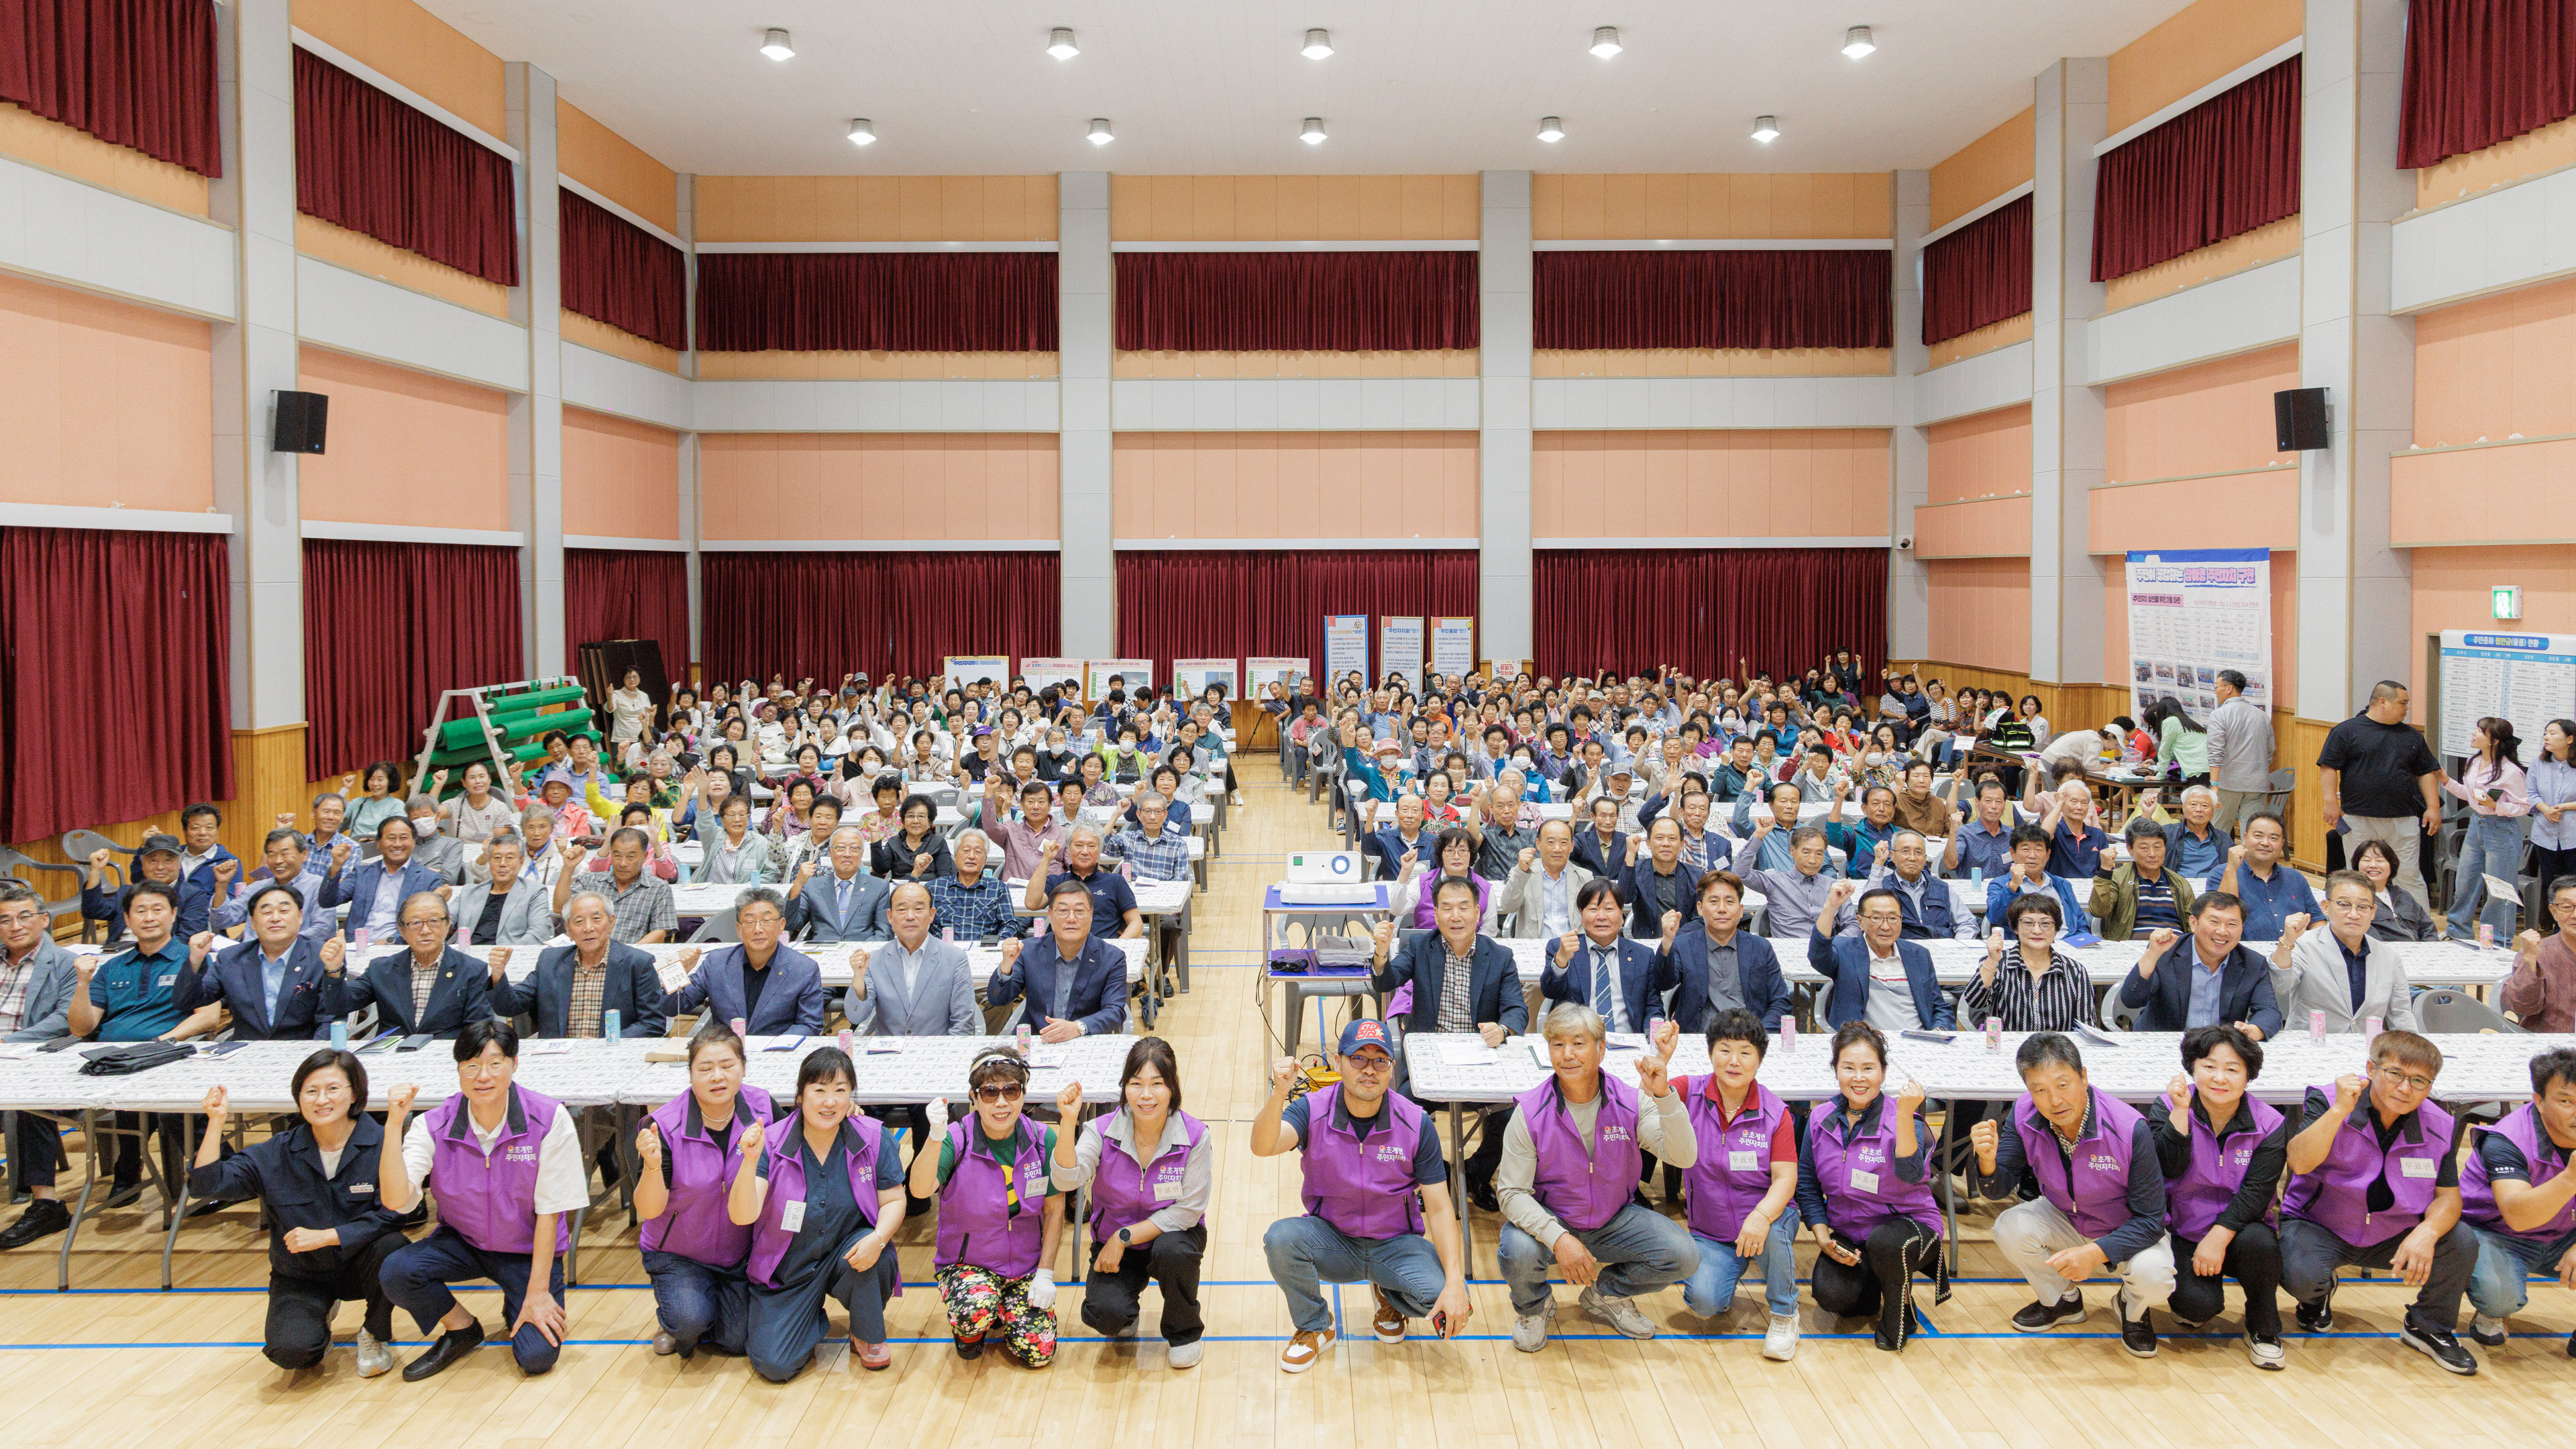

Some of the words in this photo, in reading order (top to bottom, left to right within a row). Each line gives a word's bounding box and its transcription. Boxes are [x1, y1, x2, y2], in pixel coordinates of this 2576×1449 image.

[2136, 568, 2156, 582] 주민이
[2238, 568, 2255, 584] 구현
[2473, 636, 2493, 645] 주민총회
[2528, 638, 2539, 648] 현황
[1748, 1131, 1766, 1141] 초계면
[1739, 1136, 1768, 1149] 주민자치회
[514, 1145, 533, 1153] 초계면
[1385, 1146, 1403, 1155] 초계면
[505, 1153, 537, 1162] 주민자치회
[1377, 1153, 1406, 1162] 주민자치회
[1731, 1155, 1755, 1163] 투표권
[1166, 1167, 1185, 1175] 초계면
[2088, 1161, 2120, 1172] 주민자치회
[1854, 1173, 1877, 1186] 투표권
[1028, 1180, 1046, 1191] 투표권
[1156, 1185, 1179, 1194] 투표권
